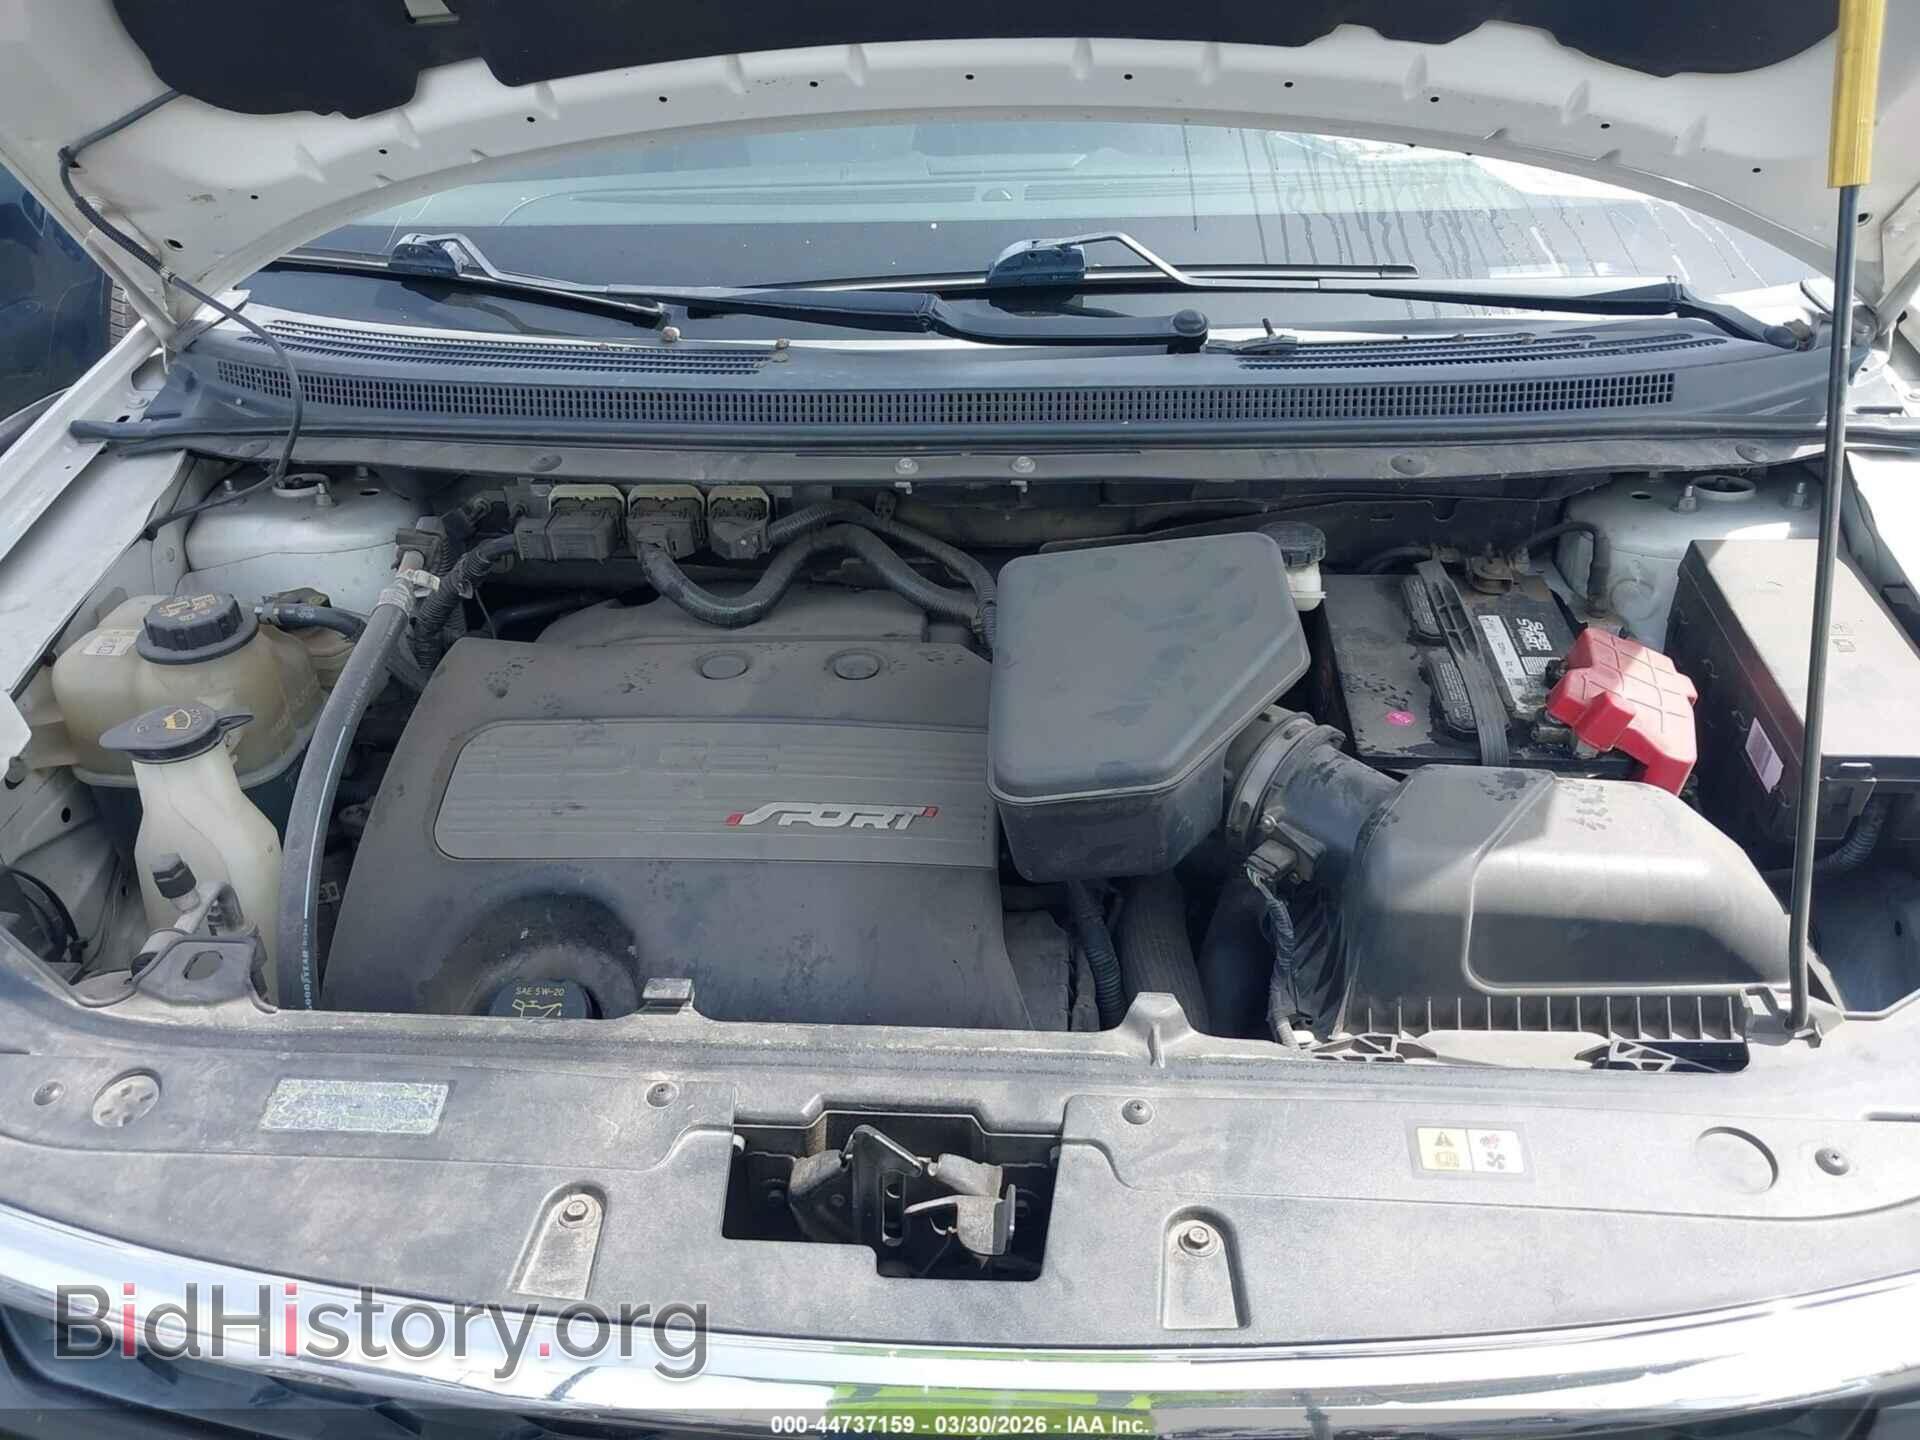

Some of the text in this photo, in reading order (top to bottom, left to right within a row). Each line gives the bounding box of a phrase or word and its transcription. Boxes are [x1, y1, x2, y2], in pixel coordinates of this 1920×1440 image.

[1516, 617, 1538, 649] START
[1533, 621, 1552, 651] SUPER
[726, 801, 939, 830] SPORT
[515, 986, 533, 996] SAE
